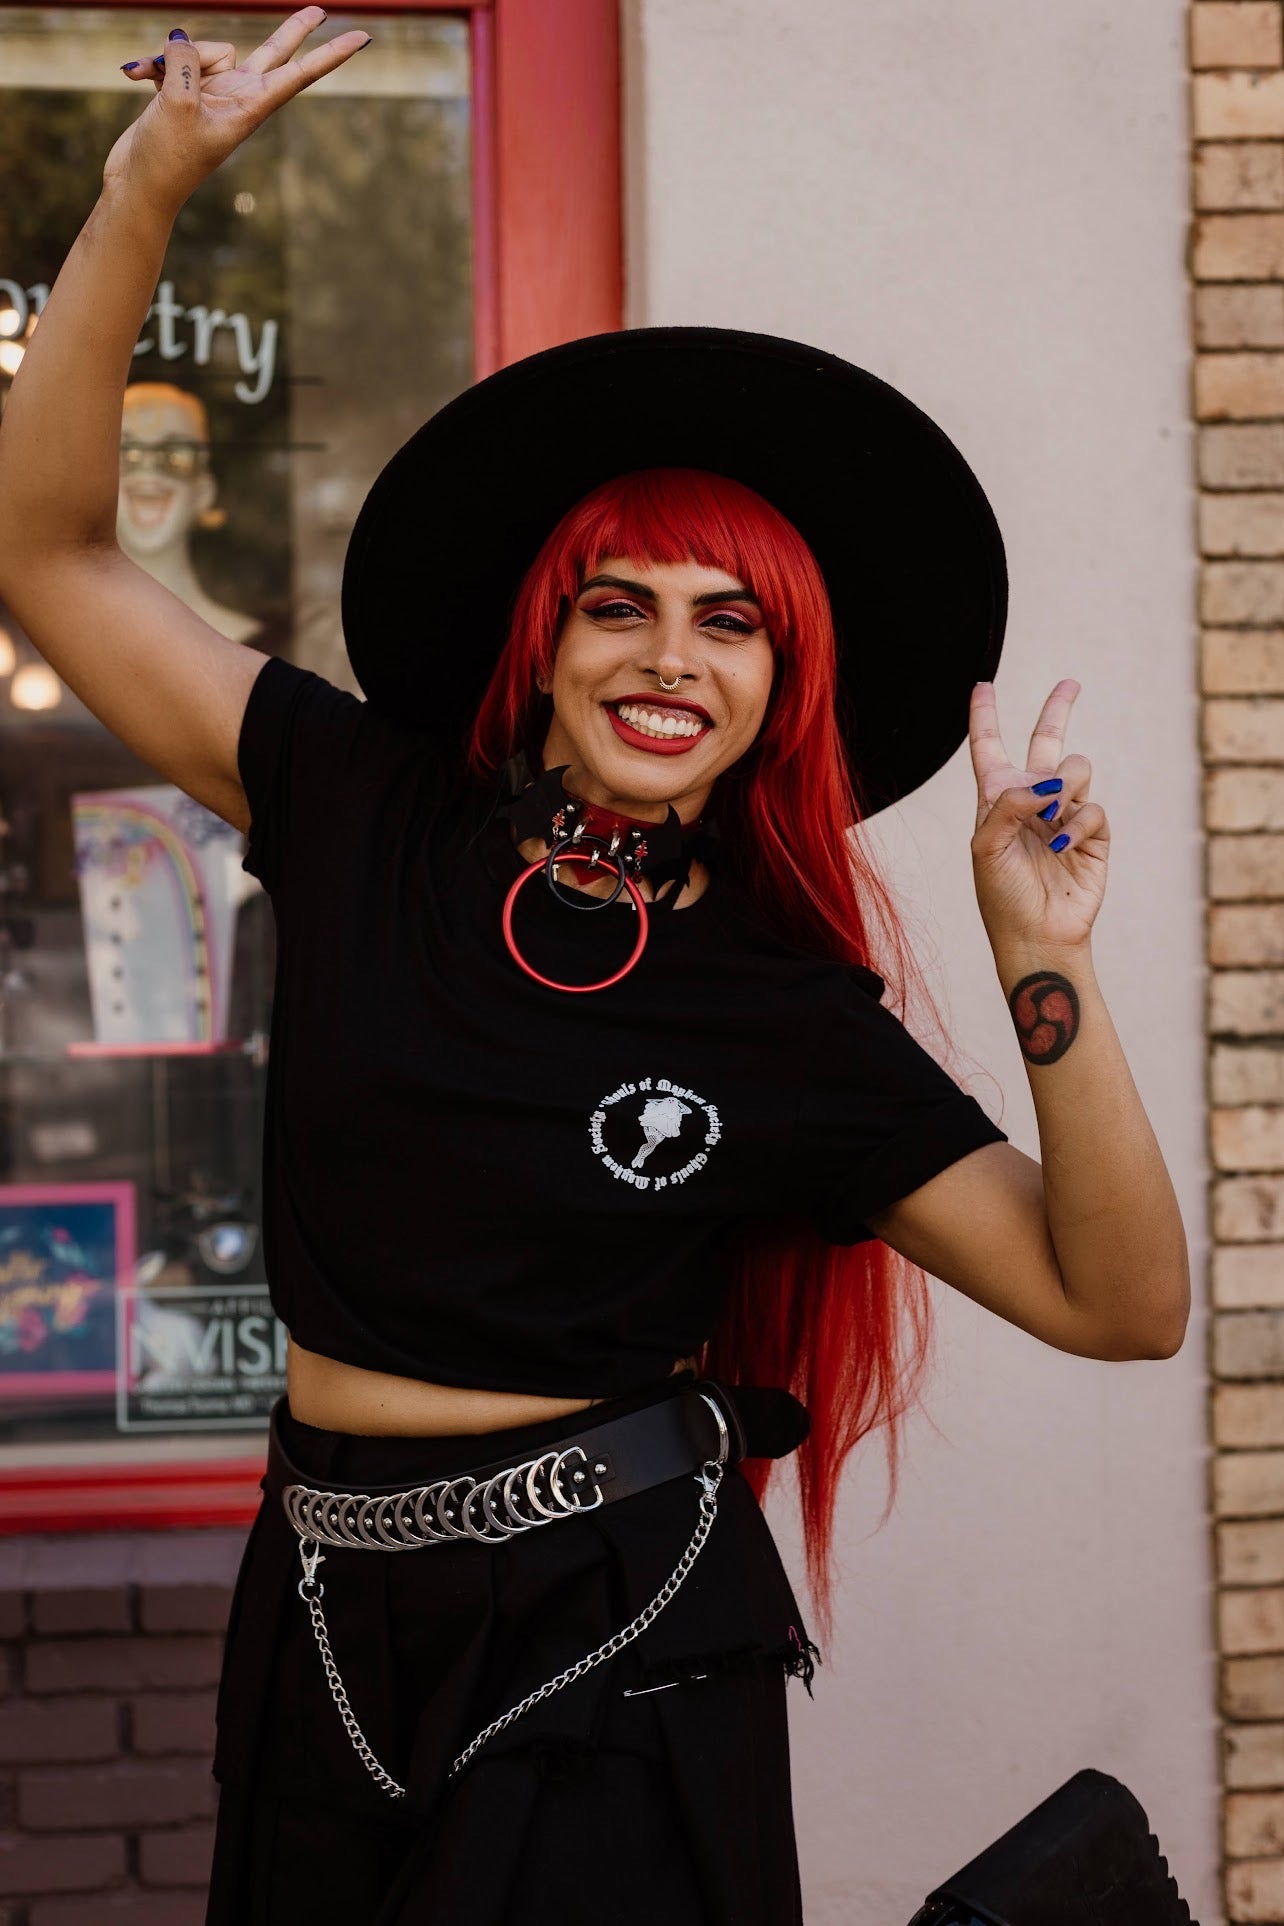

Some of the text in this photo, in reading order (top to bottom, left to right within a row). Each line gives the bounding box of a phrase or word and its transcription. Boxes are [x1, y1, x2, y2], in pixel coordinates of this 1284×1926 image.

[638, 1077, 652, 1091] of
[655, 1079, 707, 1105] Mayhem
[701, 1104, 723, 1146] Society
[588, 1110, 708, 1191] Ghouls of Mayhem Society
